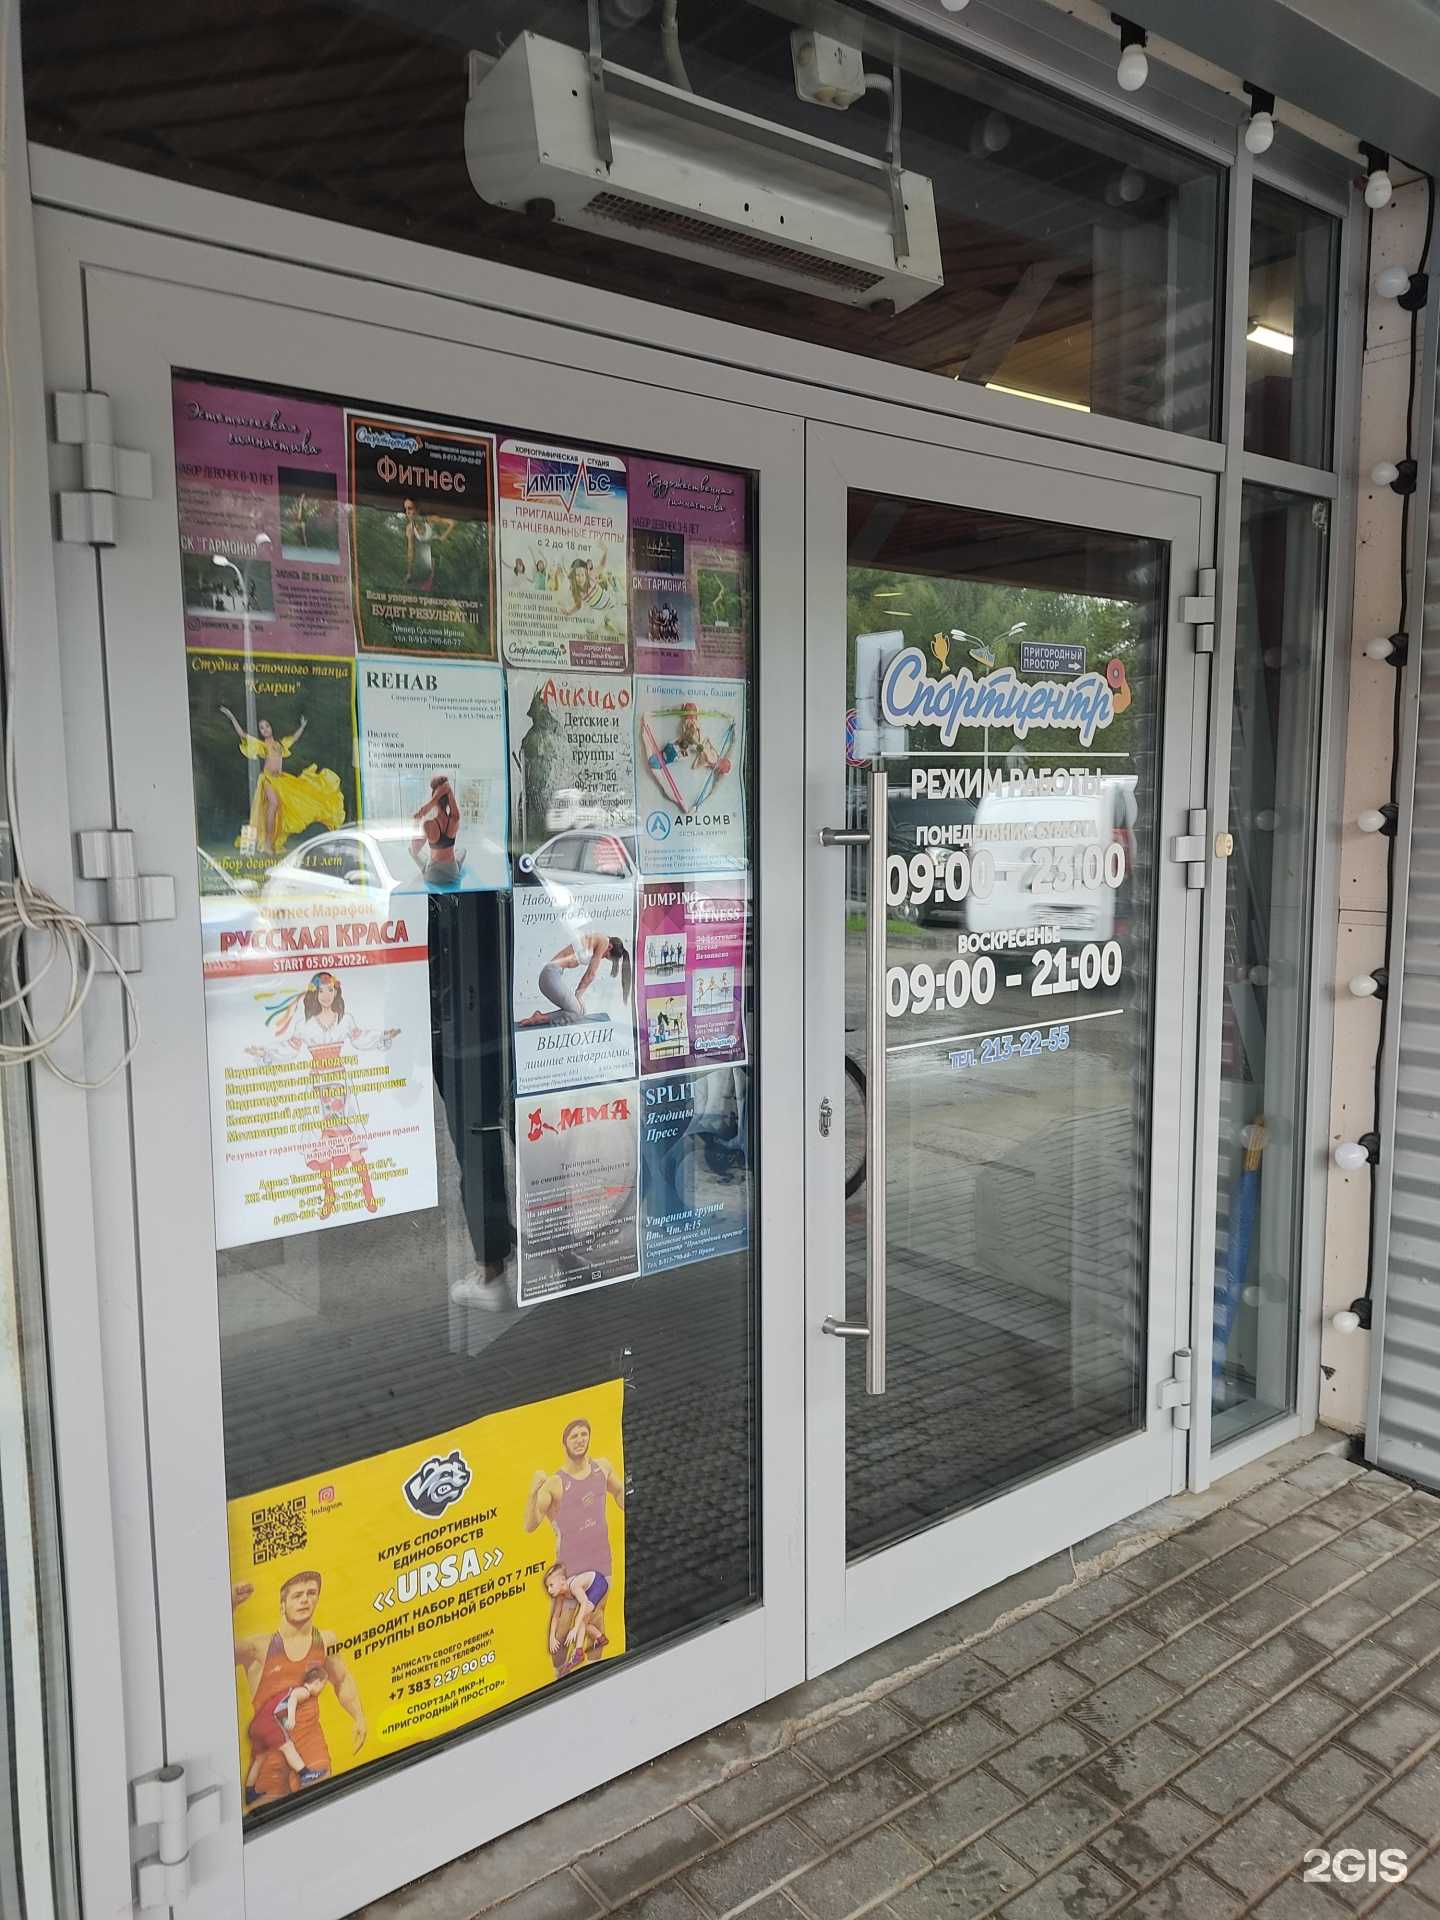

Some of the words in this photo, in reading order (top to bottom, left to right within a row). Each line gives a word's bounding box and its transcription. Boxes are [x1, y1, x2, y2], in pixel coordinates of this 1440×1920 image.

[515, 446, 579, 462] ХОРЕОГРАФИЧЕСКАЯ
[587, 458, 610, 468] СТУДИЯ
[516, 506, 581, 523] ПРИГЛАШАЕМ
[584, 516, 613, 529] ДЕТЕЙ
[511, 520, 588, 538] ТАНЦЕВАЛЬНЫЕ
[589, 530, 625, 544] ГРУППЫ
[545, 539, 550, 548] 2
[552, 542, 563, 551] до
[567, 541, 575, 550] 18
[579, 544, 592, 552] лет
[372, 604, 407, 619] БУДЕТ
[409, 608, 467, 623] РЕЗУЛЬТАТ
[1023, 646, 1083, 660] ПРИГОРОДНЫЙ
[1023, 658, 1060, 670] ПРОСТОР
[191, 657, 239, 674] Студия
[312, 666, 349, 680] танца
[366, 671, 438, 691] REHAB
[542, 677, 630, 710] Айкидо
[884, 650, 1113, 744] Спортцентр
[563, 713, 609, 728] Детские
[612, 716, 620, 728] и
[567, 732, 619, 748] взрослые
[572, 750, 615, 766] группы
[911, 768, 1002, 800] РЕЖИМ
[1009, 767, 1101, 797] РАБОТЫ
[674, 814, 731, 826] APLOMB
[886, 849, 996, 907] 09:00
[1030, 842, 1126, 895] 23:00
[643, 891, 698, 910] JUMPING
[521, 911, 559, 925] группу
[220, 925, 330, 954] РУССКАЯ
[336, 919, 409, 948] КРАСА
[958, 925, 1061, 954] ВОСКРЕСЕНЬЕ
[272, 956, 305, 972] START
[886, 955, 996, 1018] 09:00
[1031, 940, 1123, 997] 21:00
[537, 1028, 615, 1051] ВЫДОХНИ
[949, 1049, 978, 1070] ТЕЛ.
[980, 1025, 1070, 1065] 213-22-55
[645, 1081, 697, 1106] SPLIT
[646, 1108, 694, 1126] Ягодицы
[646, 1126, 679, 1143] Пресс
[645, 1209, 692, 1227] Утренняя
[377, 1541, 412, 1562] КЛУБ
[414, 1508, 498, 1546] СПОРТИВНЫХ
[393, 1527, 484, 1570] ЕДИНОБОРСТВ
[326, 1612, 411, 1657] ПРОИЗВОДИТ
[413, 1596, 454, 1620] НАБОР
[458, 1580, 495, 1605] ДЕТЕЙ
[497, 1573, 514, 1586] ОТ
[515, 1569, 522, 1580] 7
[524, 1561, 547, 1577] ЛЕТ
[353, 1649, 362, 1660] В
[365, 1626, 415, 1656] ГРУППЫ
[418, 1604, 477, 1632] ВОЛЬНОЙ
[479, 1583, 526, 1610] БОРЬБЫ
[391, 1654, 432, 1674] ЗАПИСАТЬ
[432, 1642, 462, 1659] СВОЕГО
[463, 1628, 495, 1647] РЕБЕНКА
[389, 1687, 404, 1701] +7
[408, 1678, 432, 1696] 383
[434, 1673, 443, 1688] 2
[444, 1666, 461, 1683] 27
[461, 1658, 479, 1675] 90
[480, 1650, 496, 1666] 96
[391, 1674, 404, 1684] ВЫ
[405, 1661, 439, 1679] МОЖЕТЕ
[440, 1657, 451, 1667] ПО
[382, 1700, 459, 1735] «ПРИГОРОДНЫЙ
[461, 1679, 505, 1705] ПРОСТОР»
[407, 1689, 457, 1716] СПОРТЗАЛ
[458, 1677, 485, 1696] МКР-Н
